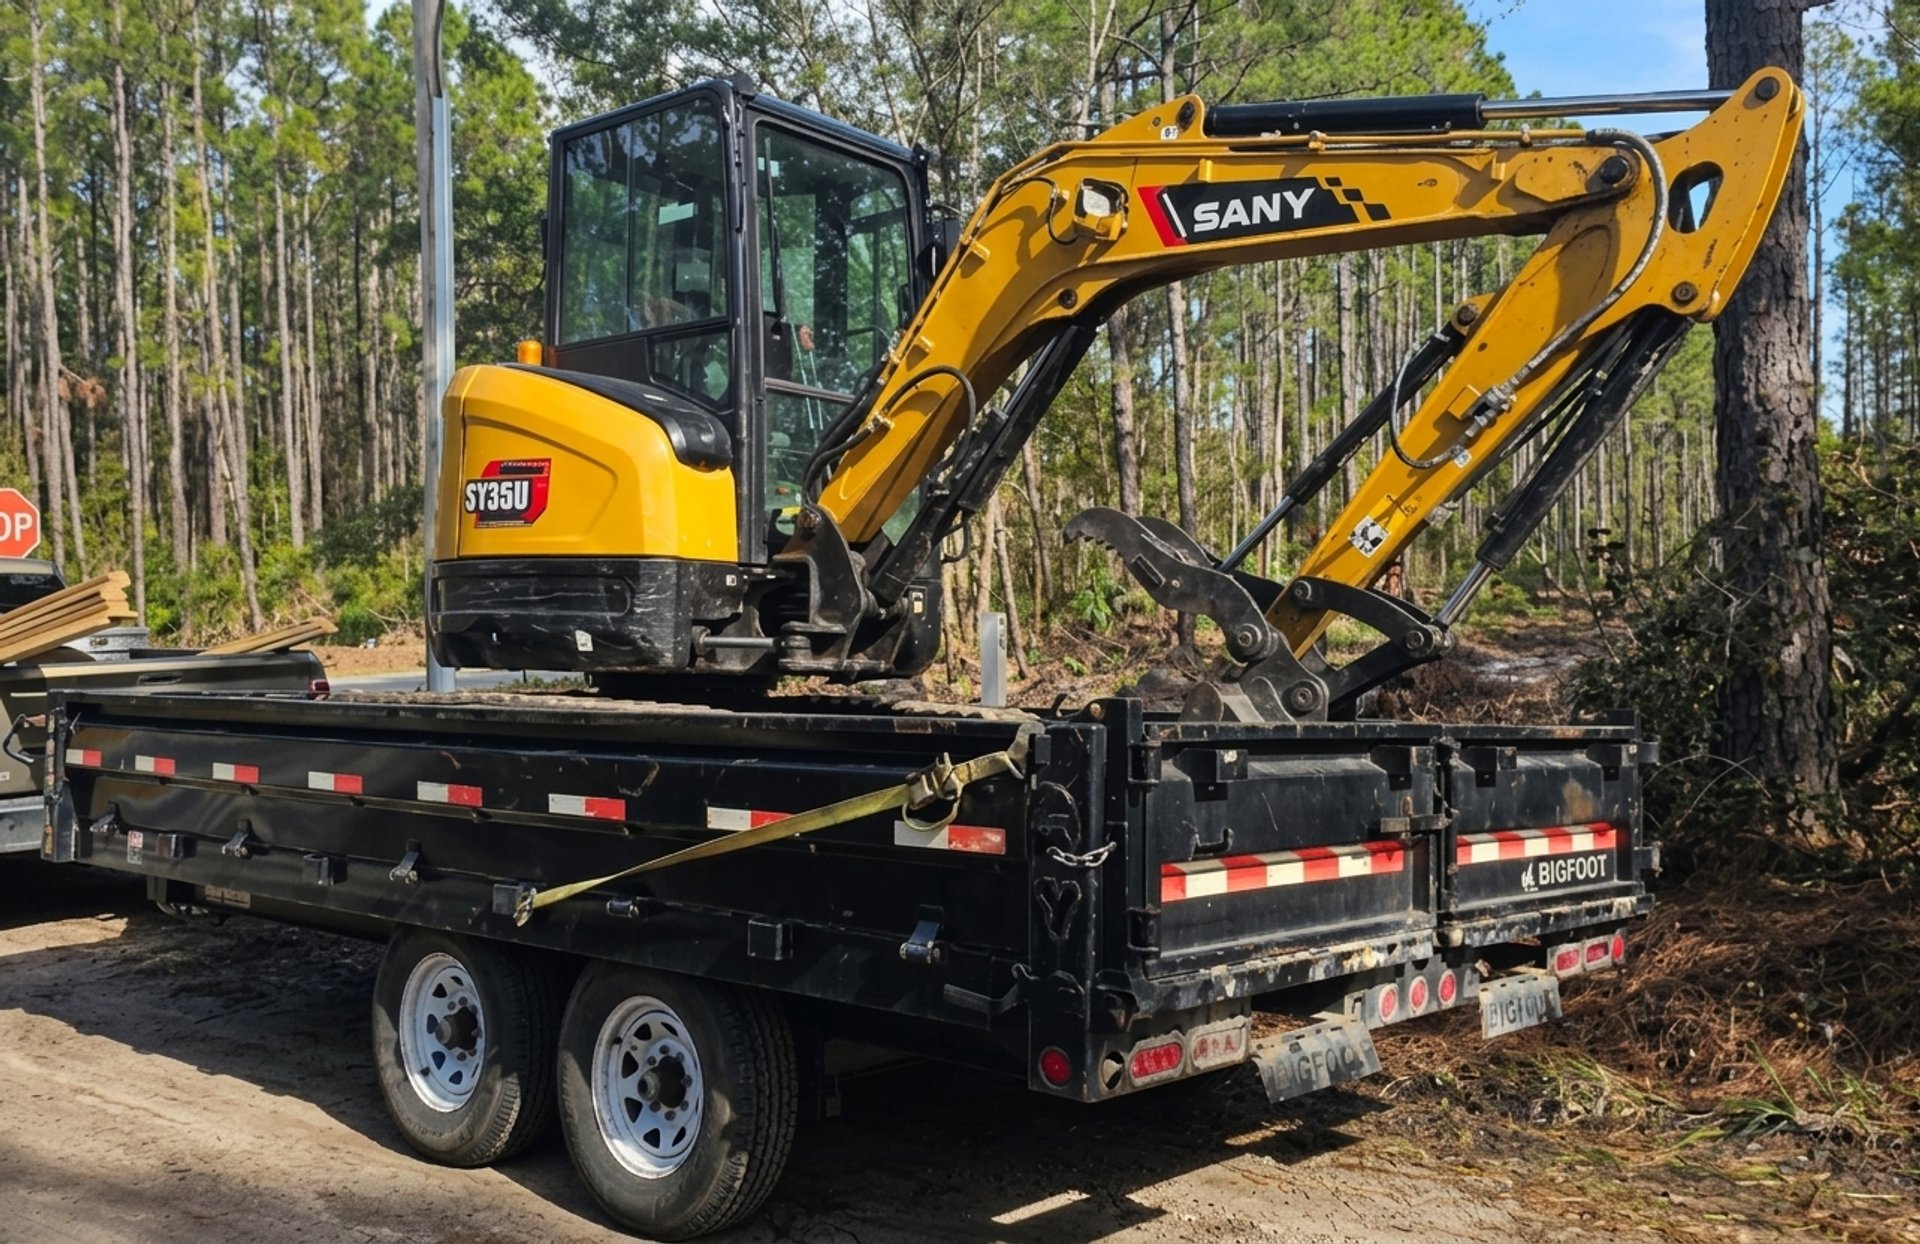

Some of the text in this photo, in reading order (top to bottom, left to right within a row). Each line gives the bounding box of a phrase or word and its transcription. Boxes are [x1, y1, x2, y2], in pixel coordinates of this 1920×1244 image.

[1193, 187, 1316, 233] SANY
[465, 480, 529, 512] SY35U
[1538, 854, 1607, 885] BIGFOOT
